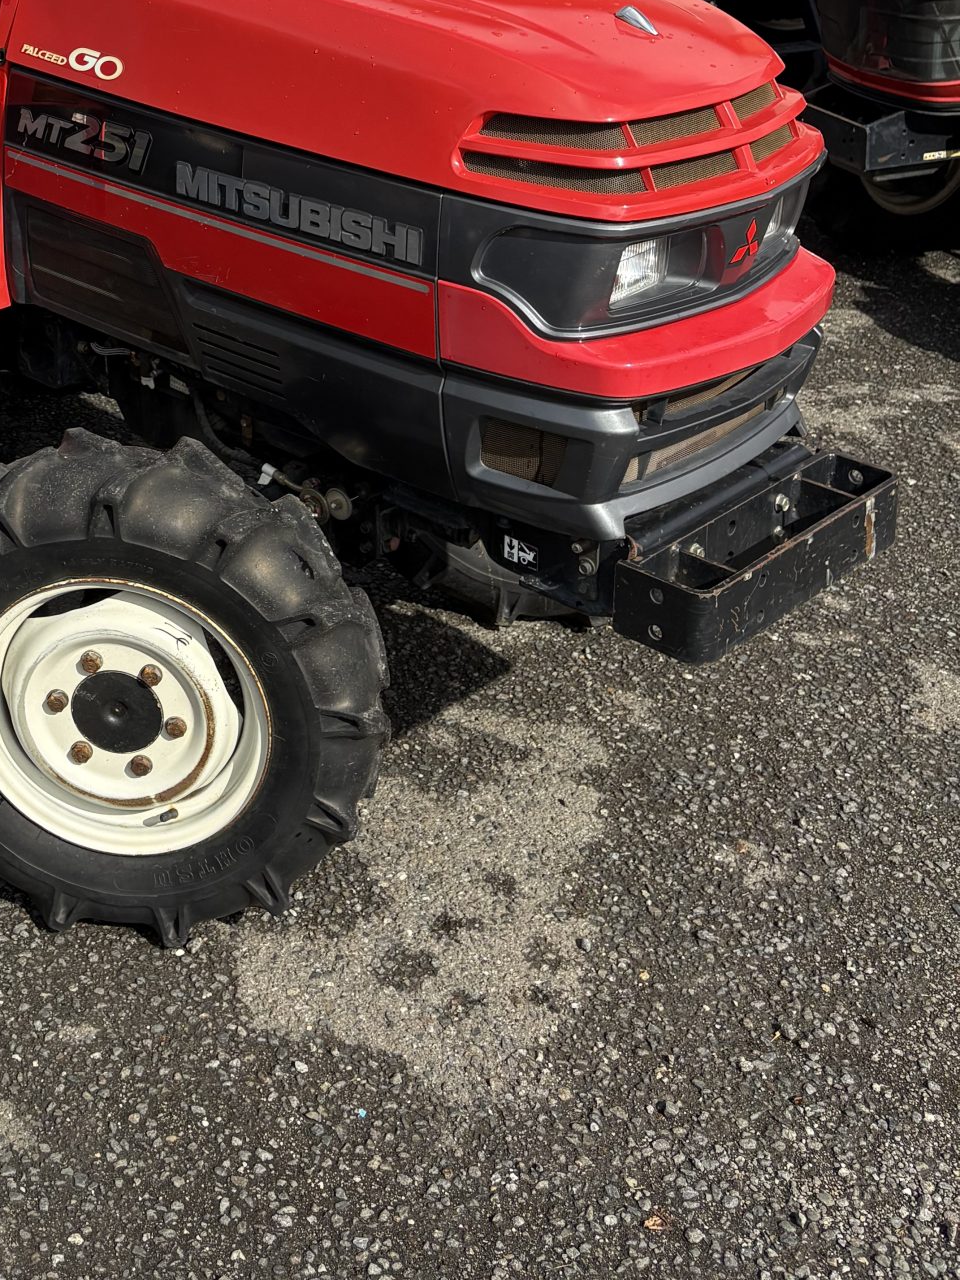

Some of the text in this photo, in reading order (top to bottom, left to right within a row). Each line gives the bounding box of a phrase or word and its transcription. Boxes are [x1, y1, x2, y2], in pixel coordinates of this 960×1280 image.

[20, 43, 124, 81] PALCEED GO
[17, 108, 153, 173] MT251
[175, 161, 423, 266] MITSUBISHI
